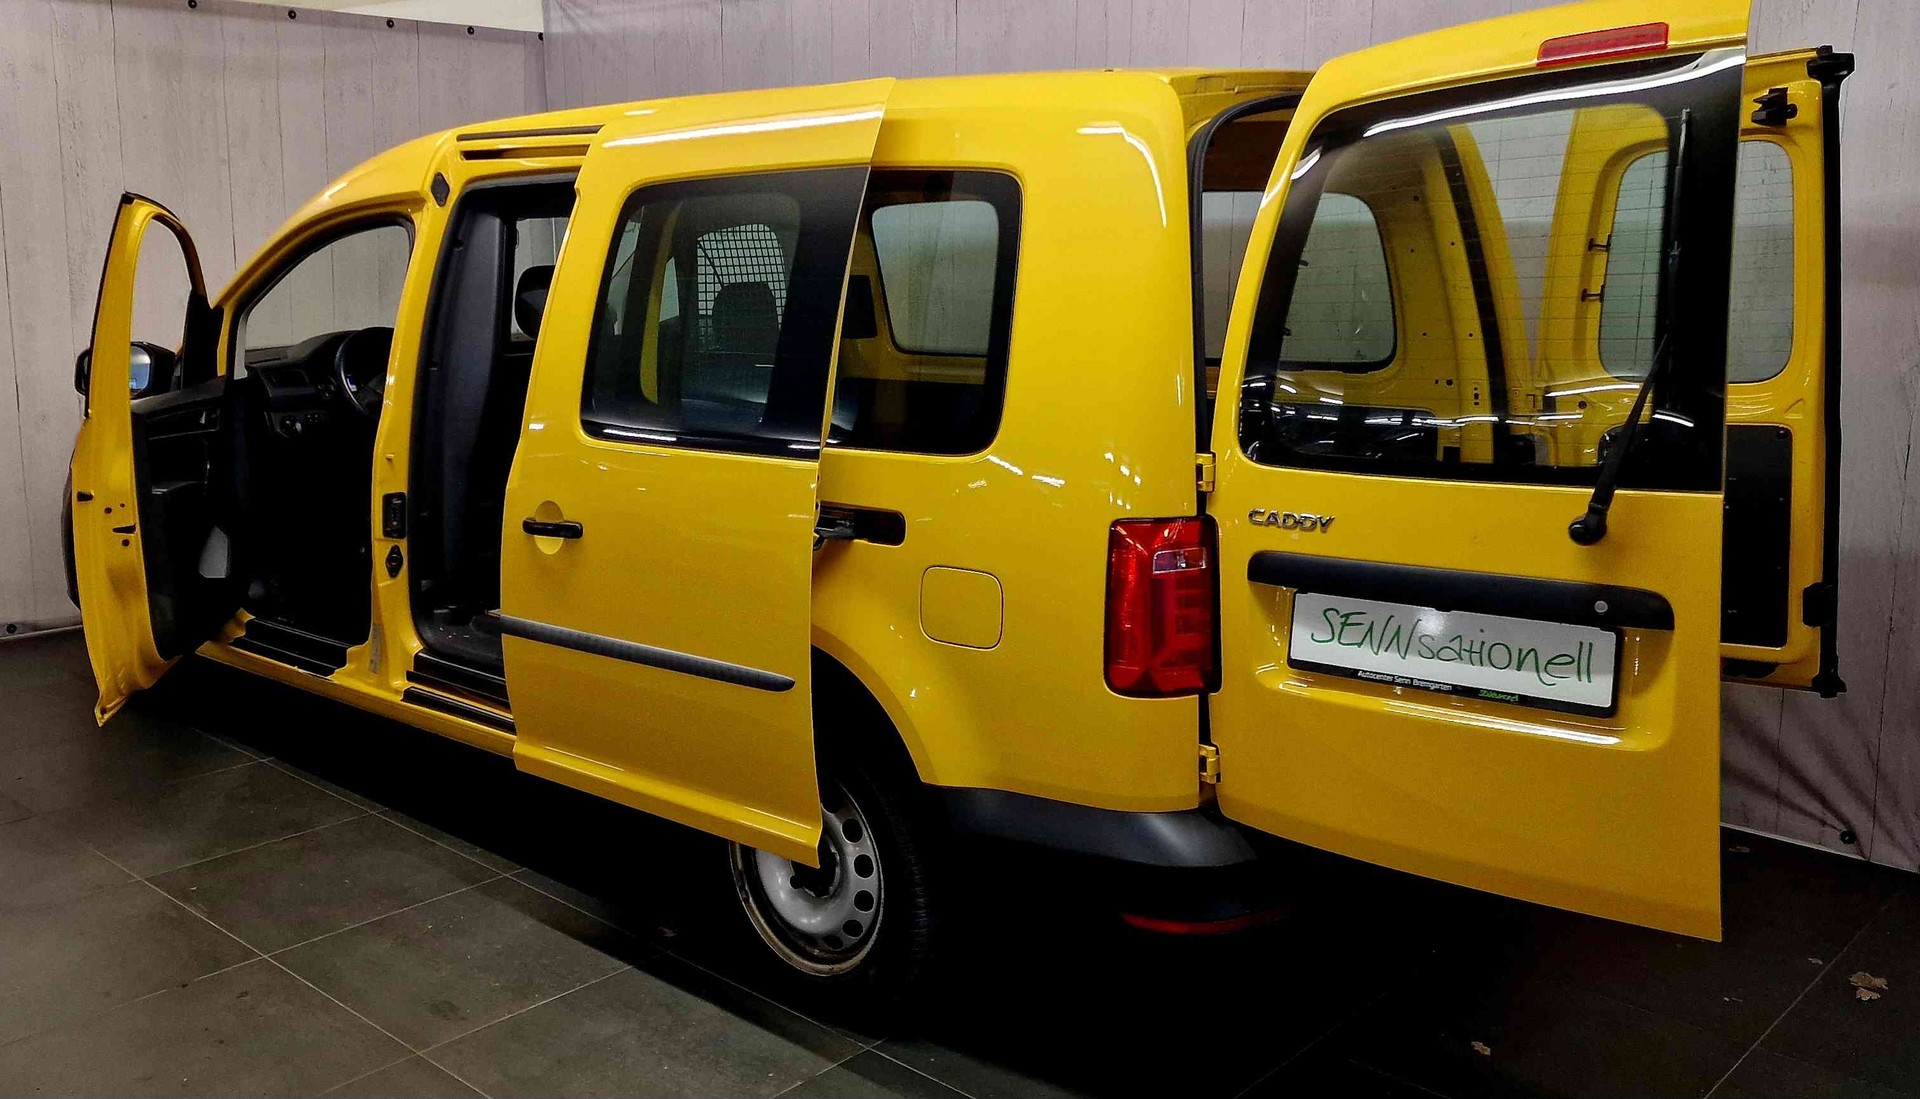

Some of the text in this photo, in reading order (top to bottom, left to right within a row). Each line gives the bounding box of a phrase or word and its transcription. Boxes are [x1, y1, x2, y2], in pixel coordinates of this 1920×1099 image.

[1248, 508, 1335, 534] CADDY
[1311, 608, 1592, 686] SENNsationell
[1357, 671, 1453, 690] Autocenter Senn Bremgarten
